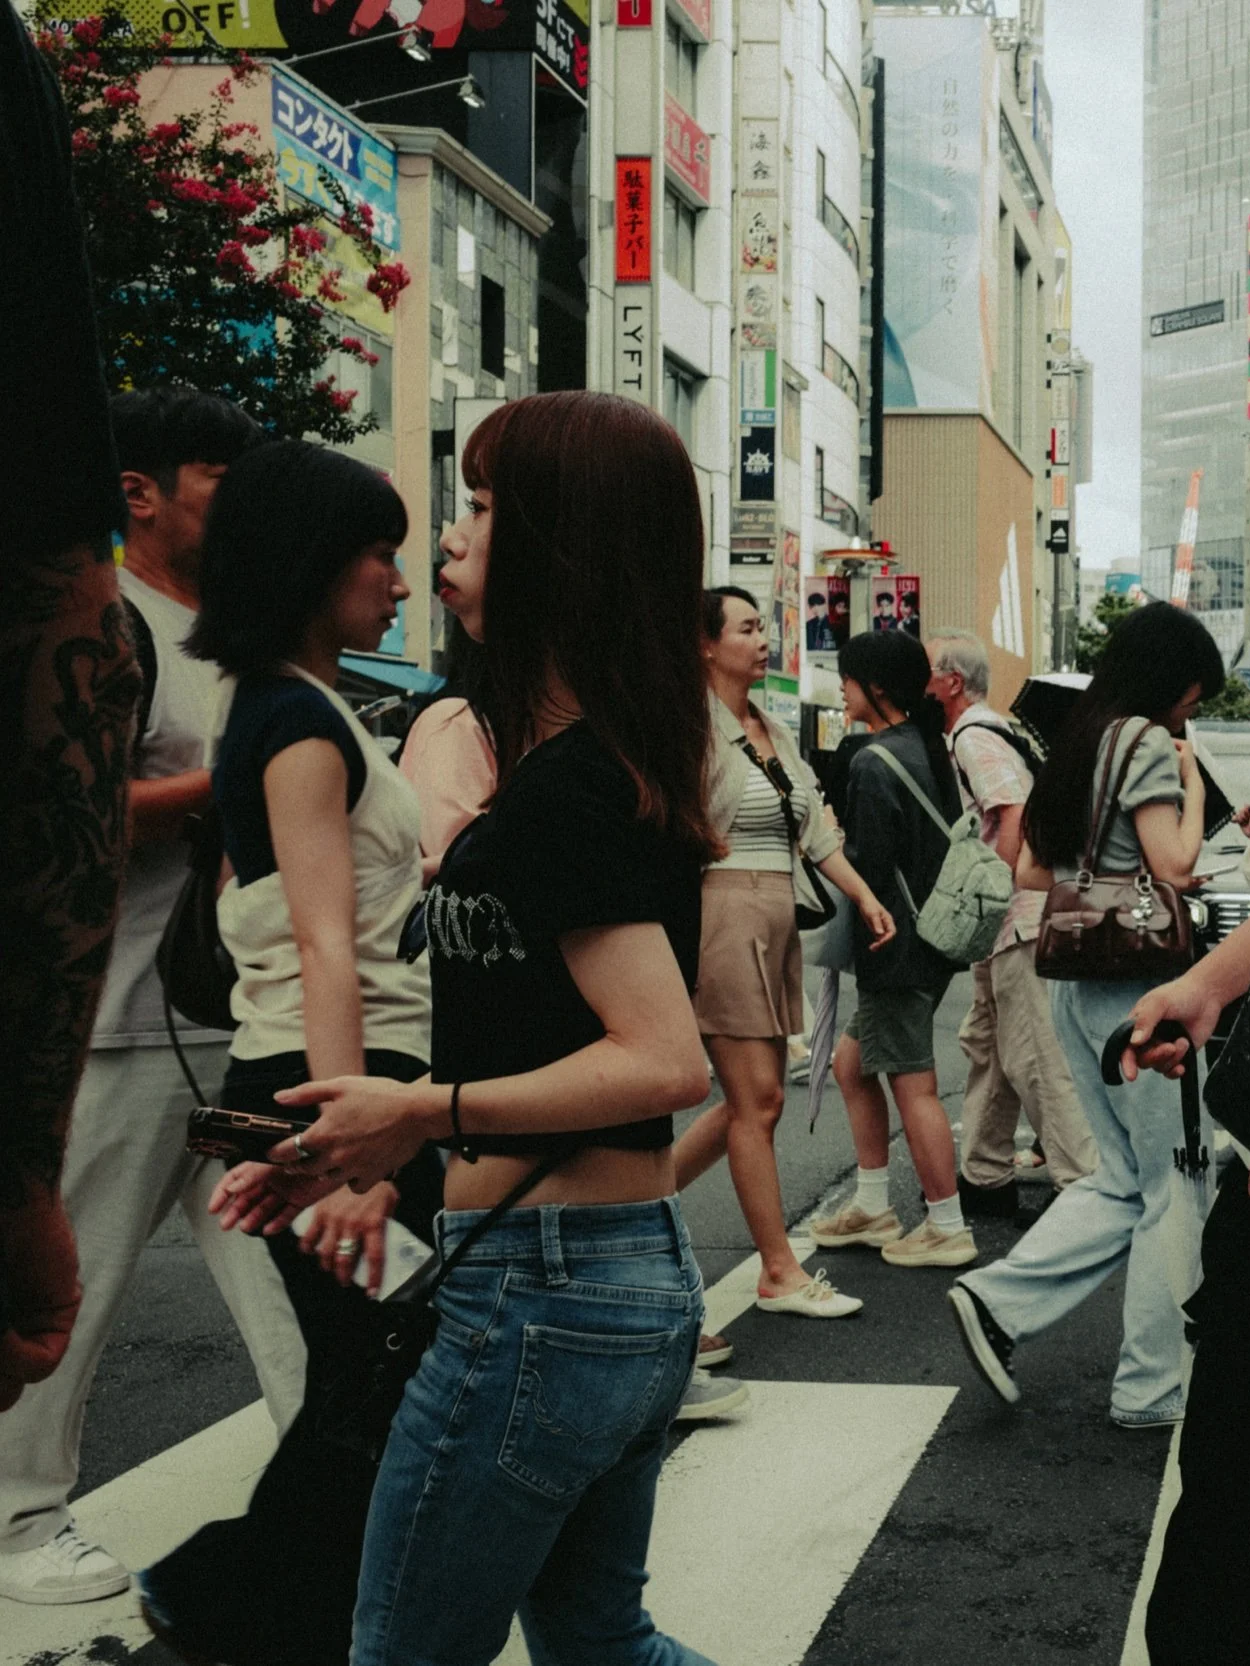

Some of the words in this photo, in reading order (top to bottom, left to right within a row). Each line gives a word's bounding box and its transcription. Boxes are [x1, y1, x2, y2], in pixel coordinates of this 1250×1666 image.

[277, 89, 354, 171] コンタクト
